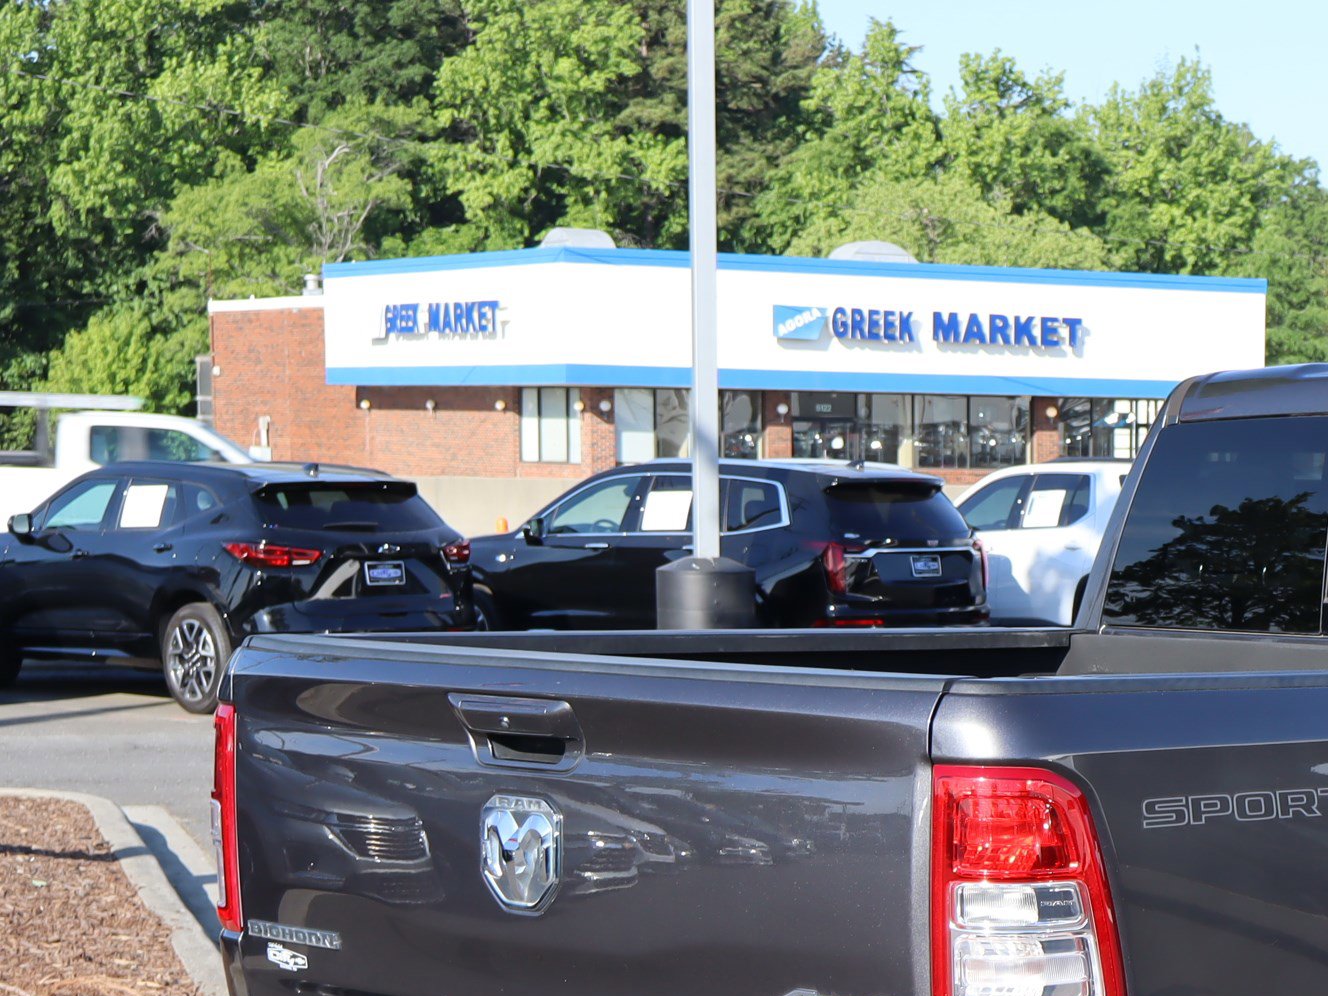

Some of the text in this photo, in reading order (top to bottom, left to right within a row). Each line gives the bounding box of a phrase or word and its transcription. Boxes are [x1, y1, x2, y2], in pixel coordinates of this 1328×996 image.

[385, 300, 499, 333] GREEK MARKET
[777, 307, 822, 336] AGORA
[832, 306, 1083, 348] GREEK MARKET
[496, 798, 544, 810] RAM
